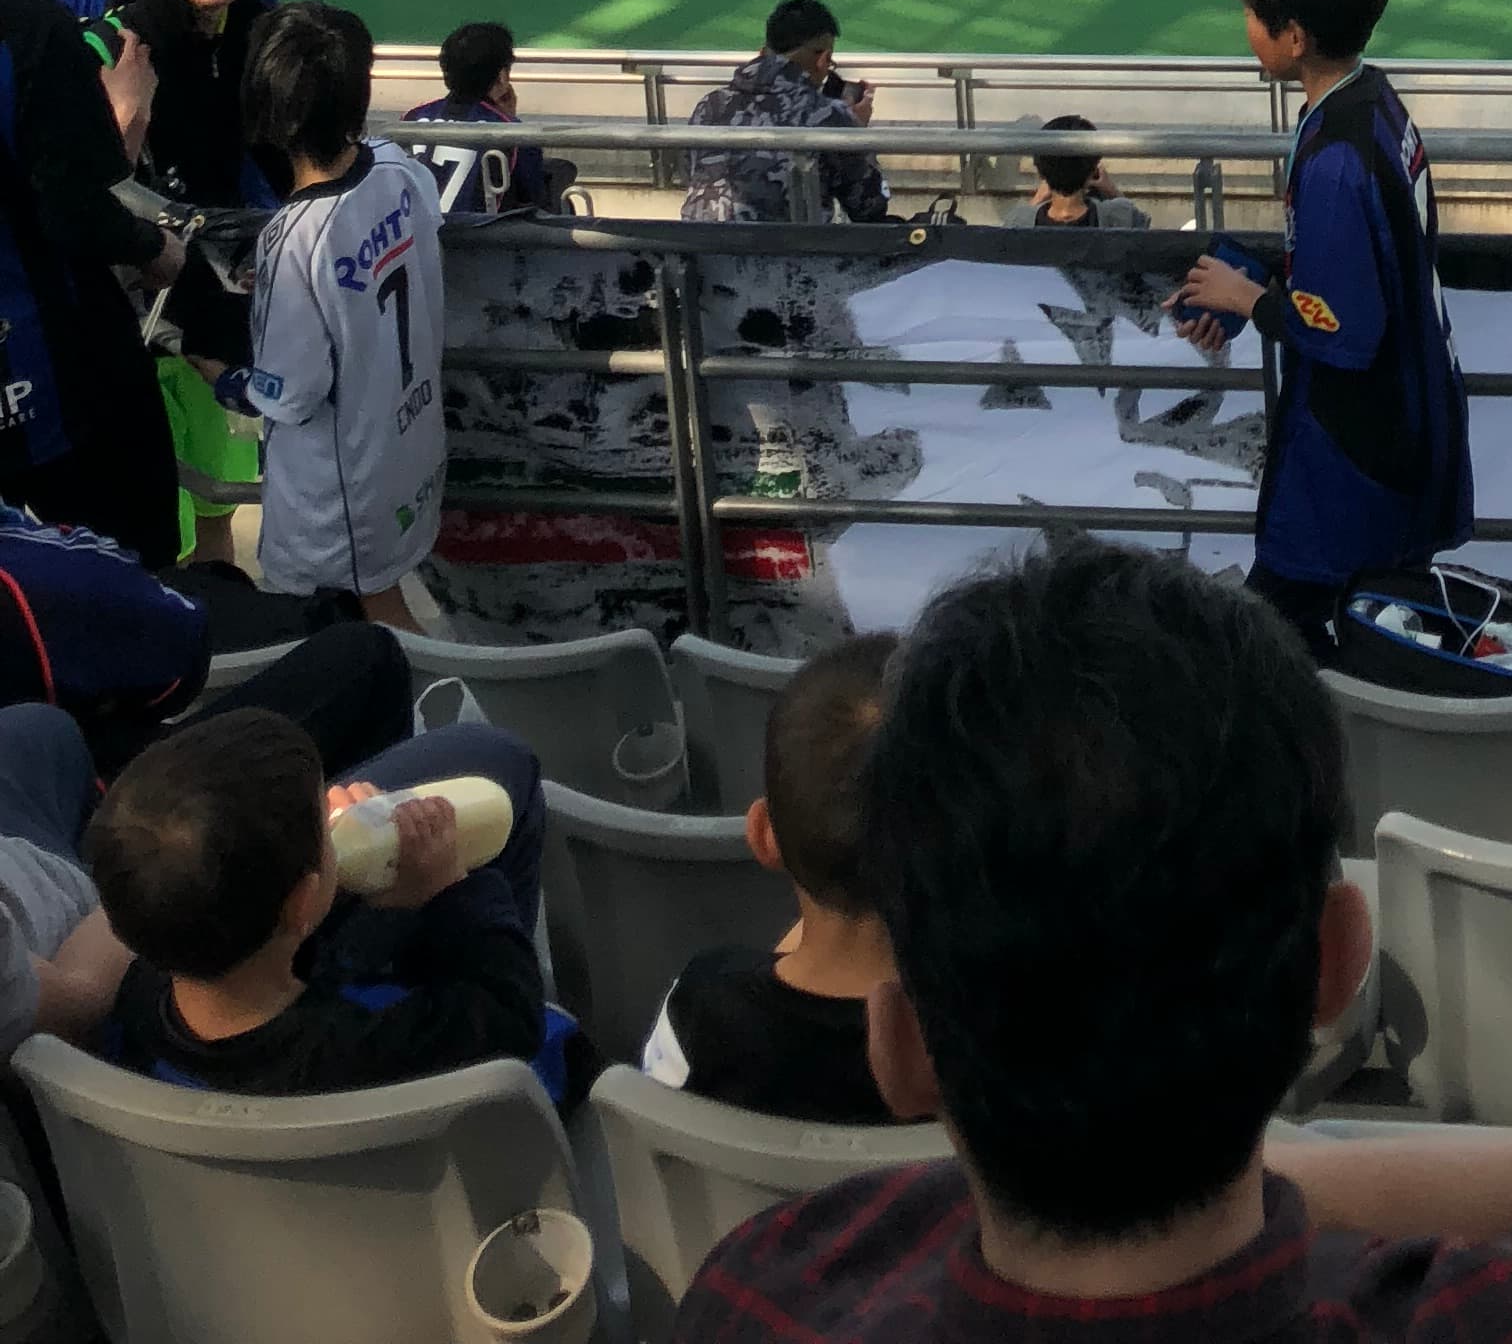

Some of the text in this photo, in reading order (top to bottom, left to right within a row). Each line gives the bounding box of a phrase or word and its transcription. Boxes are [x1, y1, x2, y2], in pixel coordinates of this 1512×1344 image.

[412, 144, 478, 213] 7
[334, 188, 412, 292] ROHTO
[0, 380, 33, 418] P
[396, 378, 433, 436] ENDO
